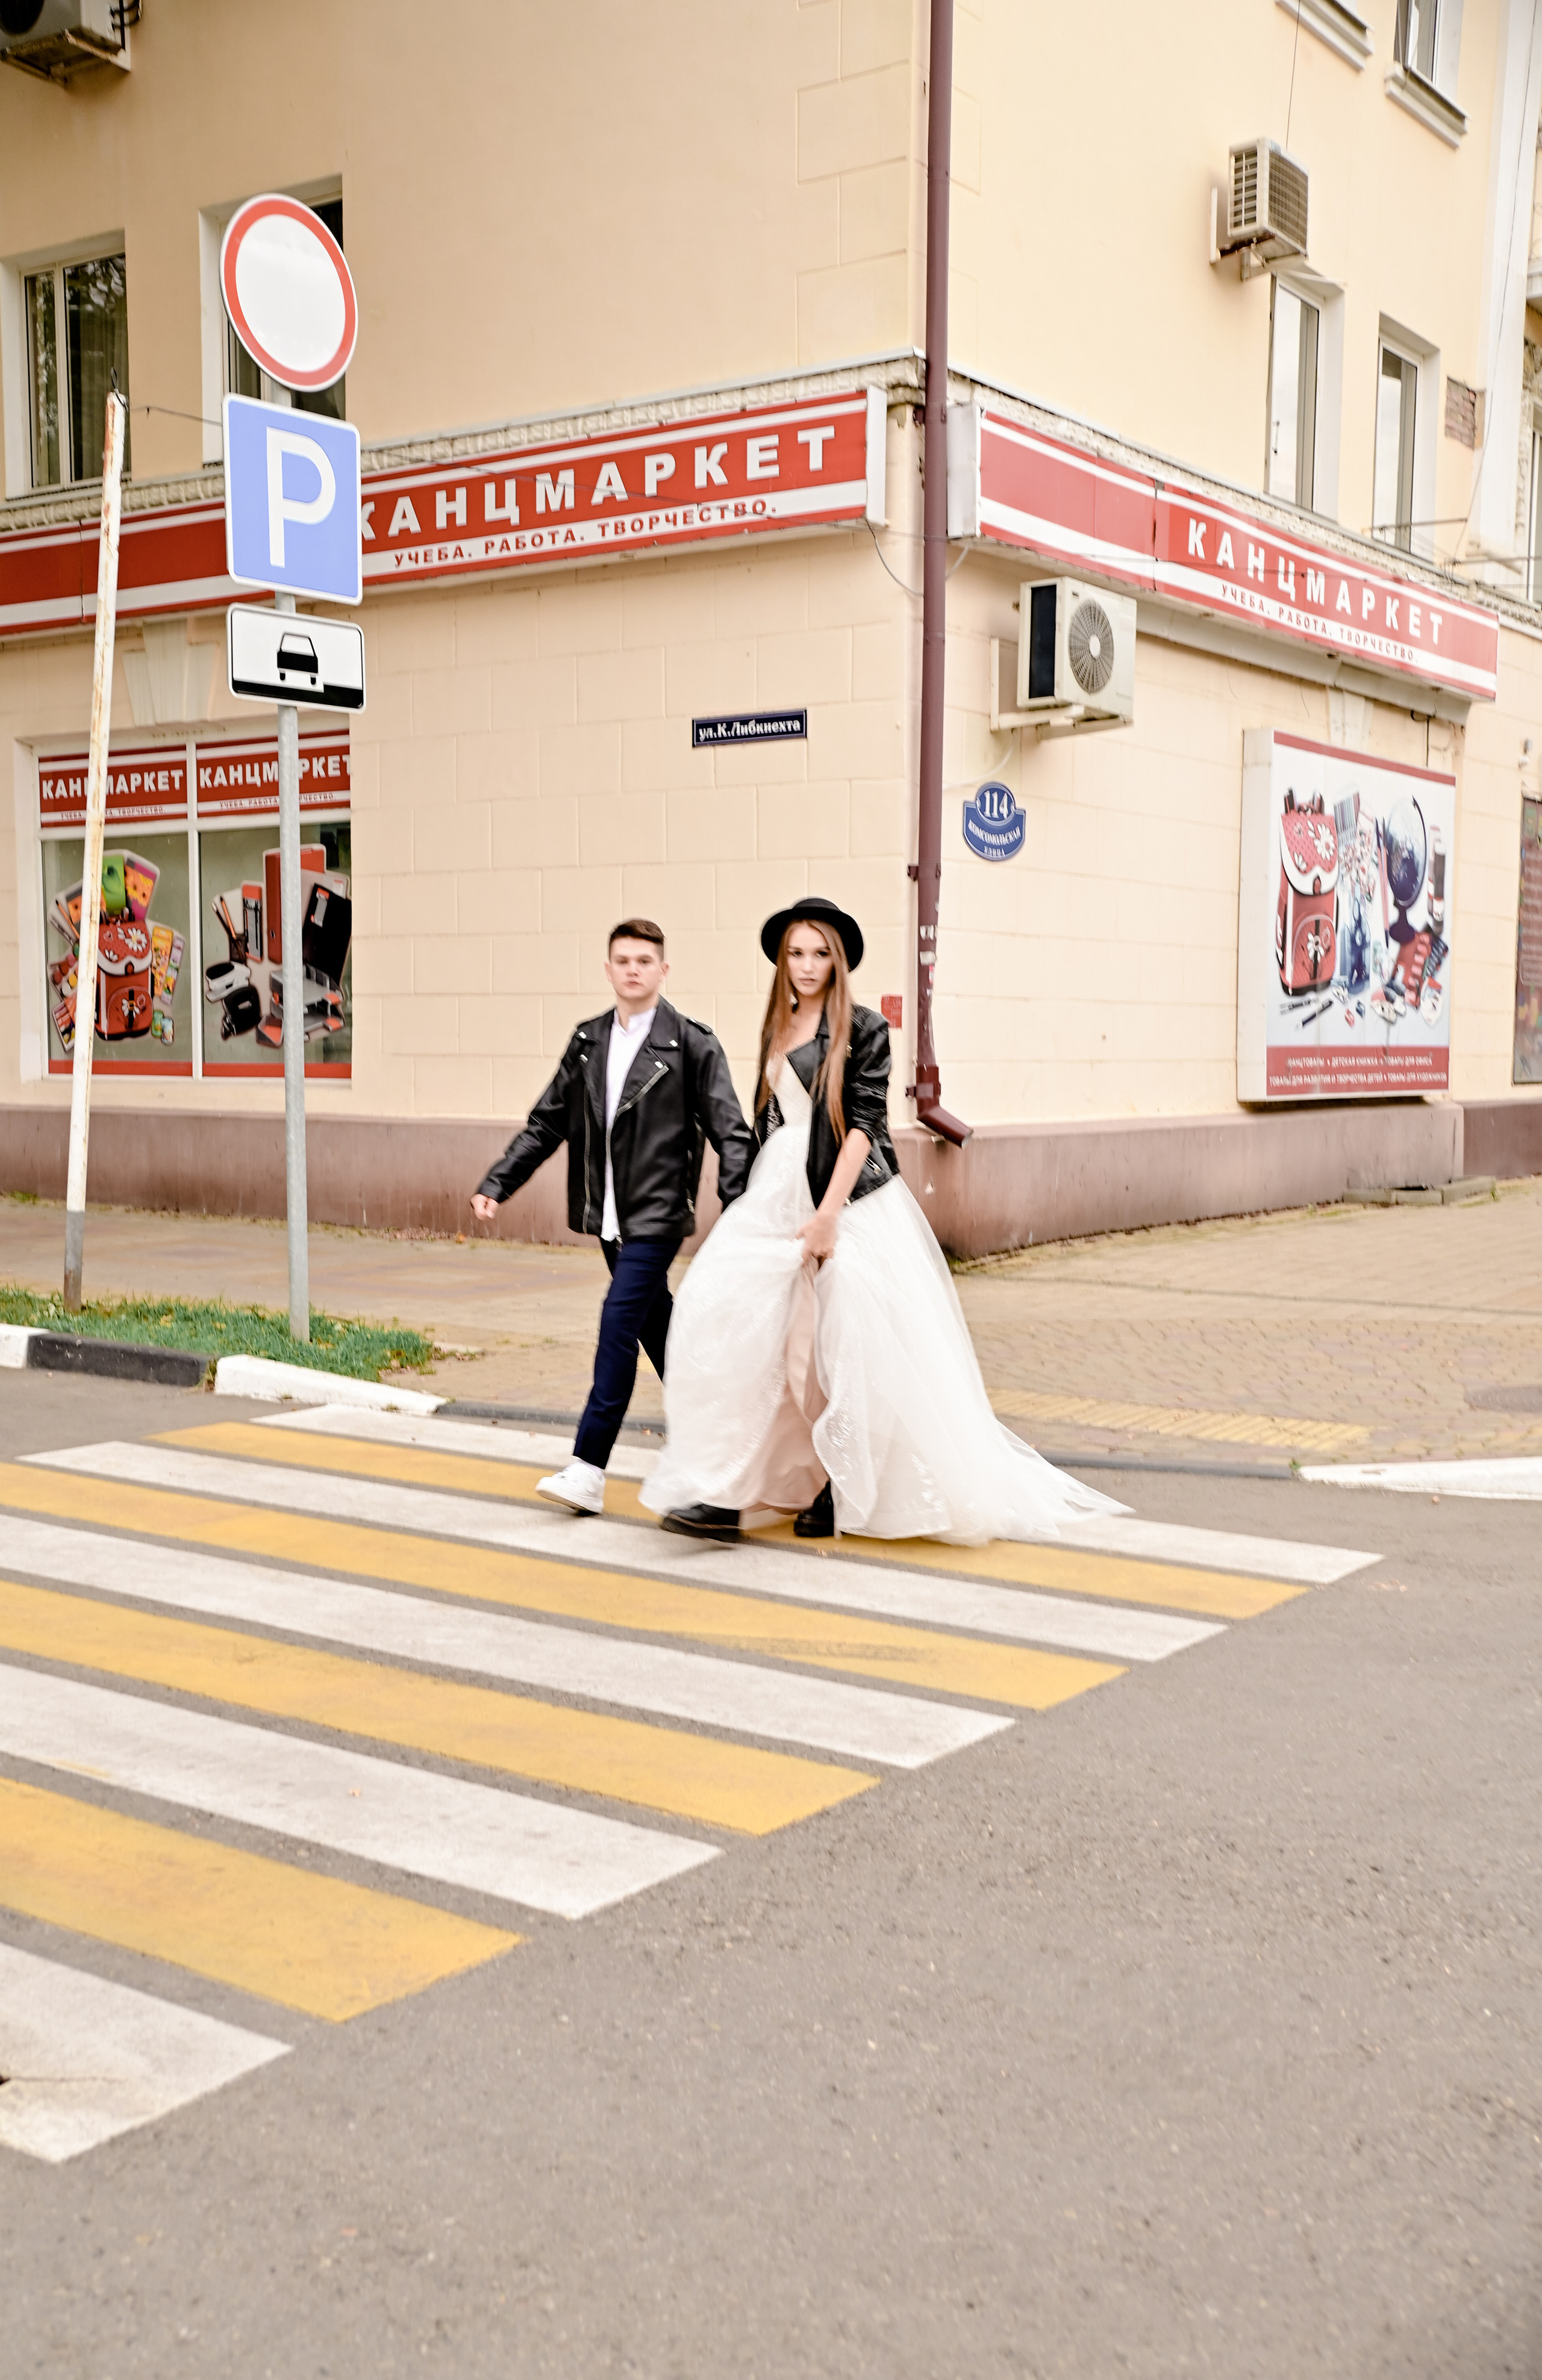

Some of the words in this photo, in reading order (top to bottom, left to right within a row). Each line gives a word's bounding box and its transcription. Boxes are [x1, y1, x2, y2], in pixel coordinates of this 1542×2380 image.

[266, 426, 336, 568] P
[395, 544, 473, 568] УЧЕБА.
[484, 527, 585, 555] РАБОТА.
[598, 499, 776, 538] ТВОРЧЕСТВО.
[1188, 517, 1443, 645] КАНЦМАРКЕТ
[1222, 583, 1270, 615] УЧЕБА.
[1278, 606, 1332, 637] РАБОТА.
[1340, 626, 1417, 663] ТВОРЧЕСТВО.
[199, 754, 350, 788] КАНЦМРКЕТ
[983, 790, 1009, 820] 114
